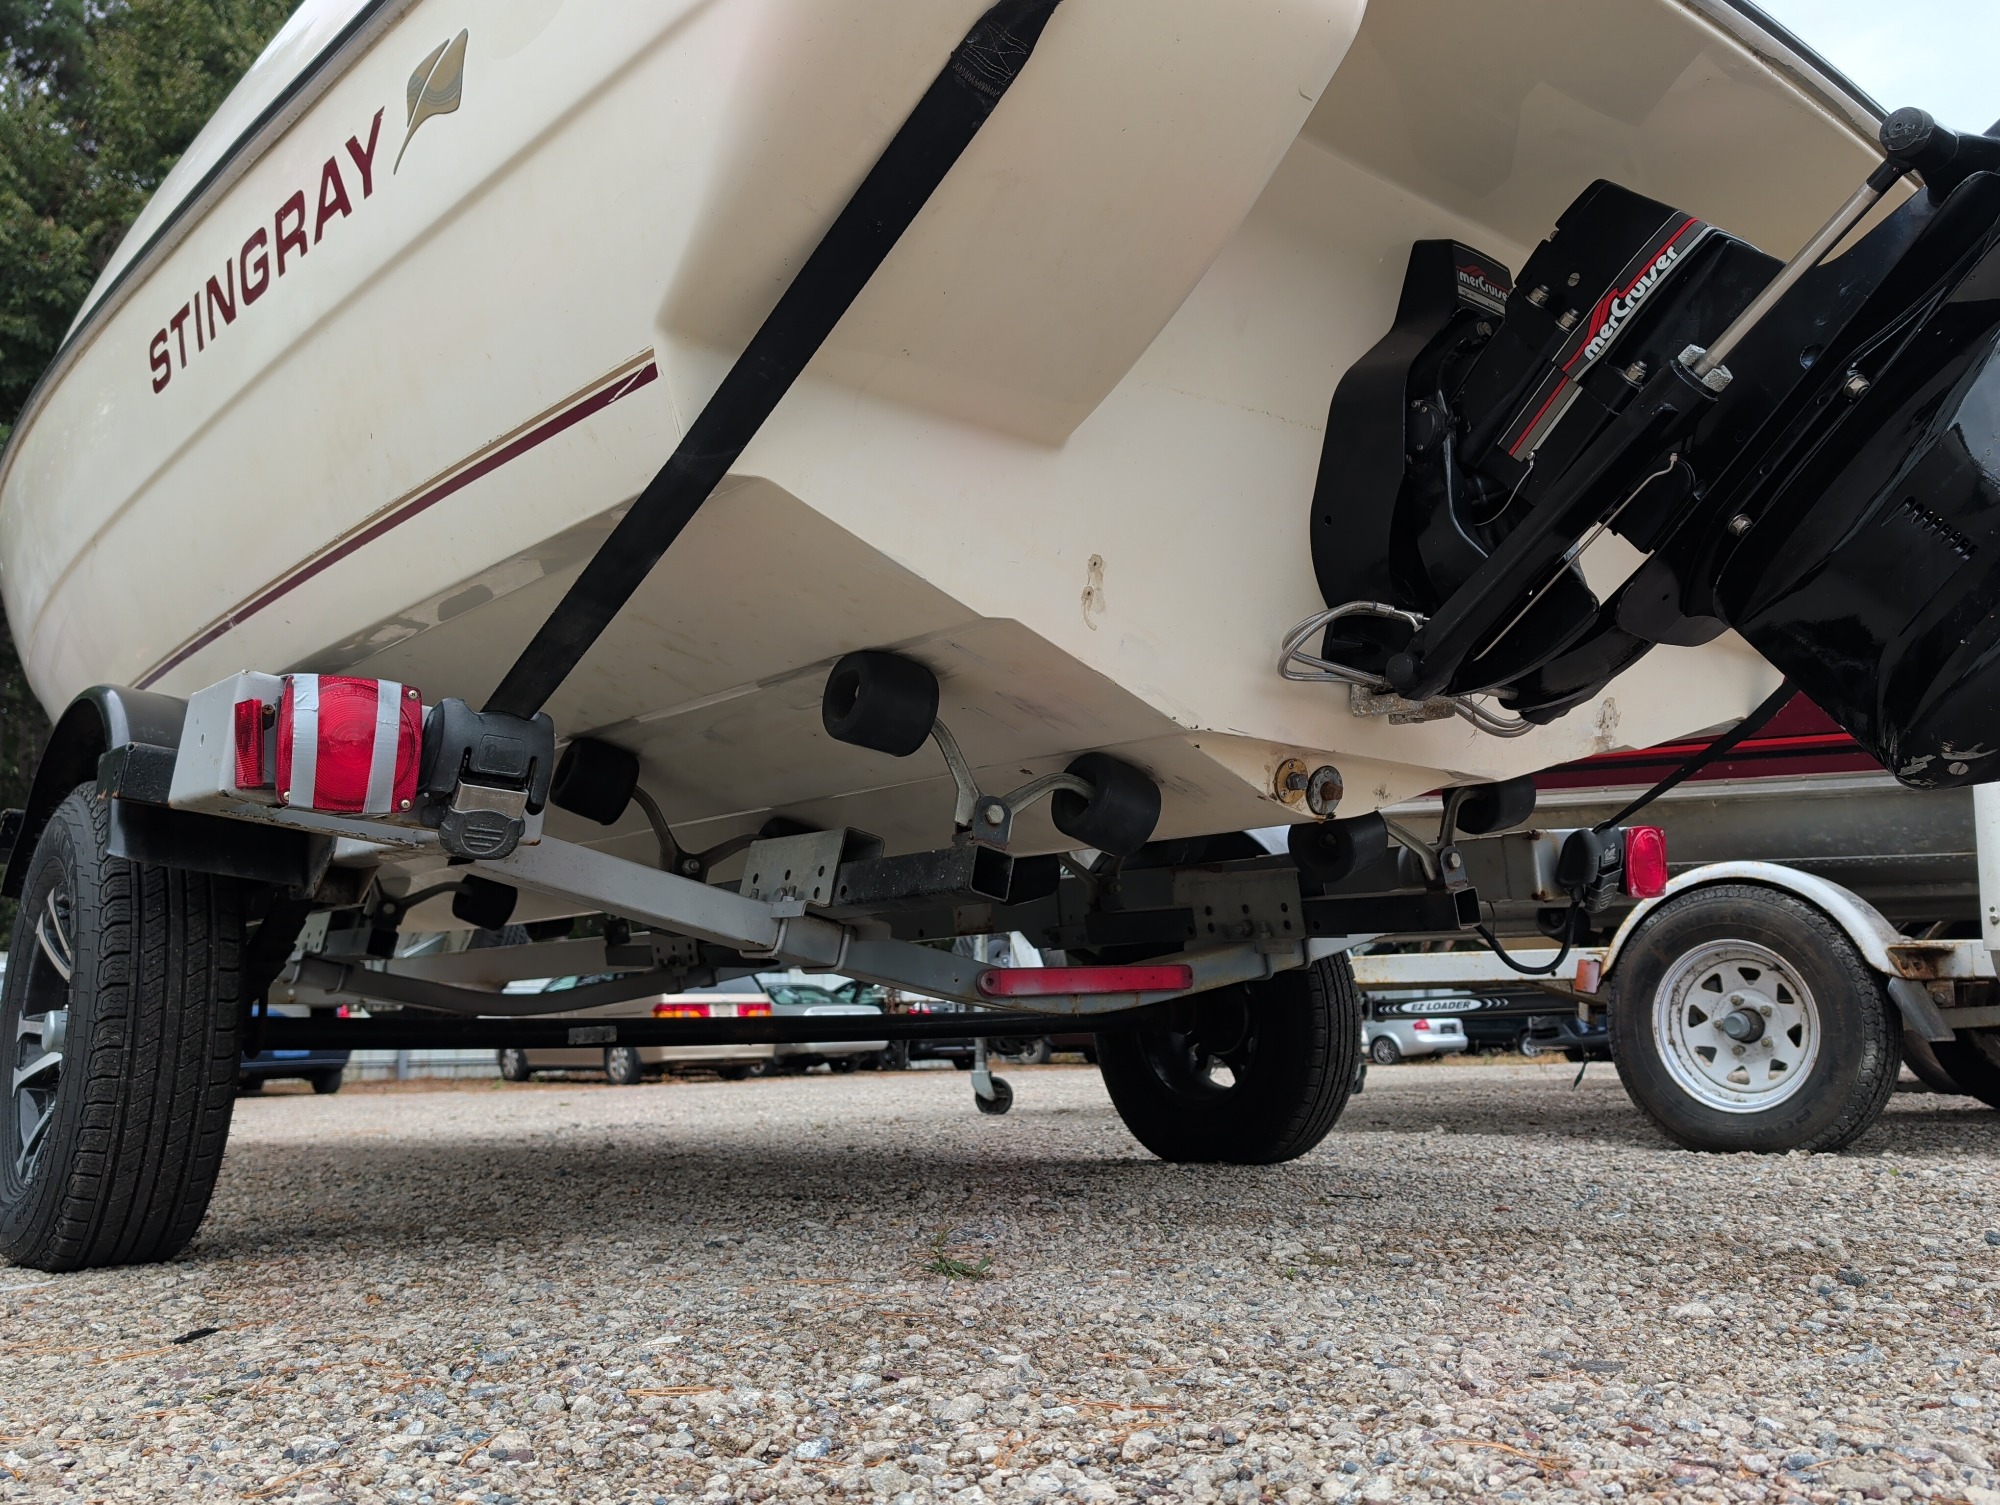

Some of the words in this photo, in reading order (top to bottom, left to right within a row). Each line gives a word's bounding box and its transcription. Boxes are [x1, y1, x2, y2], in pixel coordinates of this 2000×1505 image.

[149, 105, 386, 394] STINGRAY
[1459, 271, 1510, 302] merCruise
[1583, 245, 1678, 361] merCruiser
[1411, 1003, 1423, 1011] EZ
[1426, 1001, 1471, 1011] LOADER
